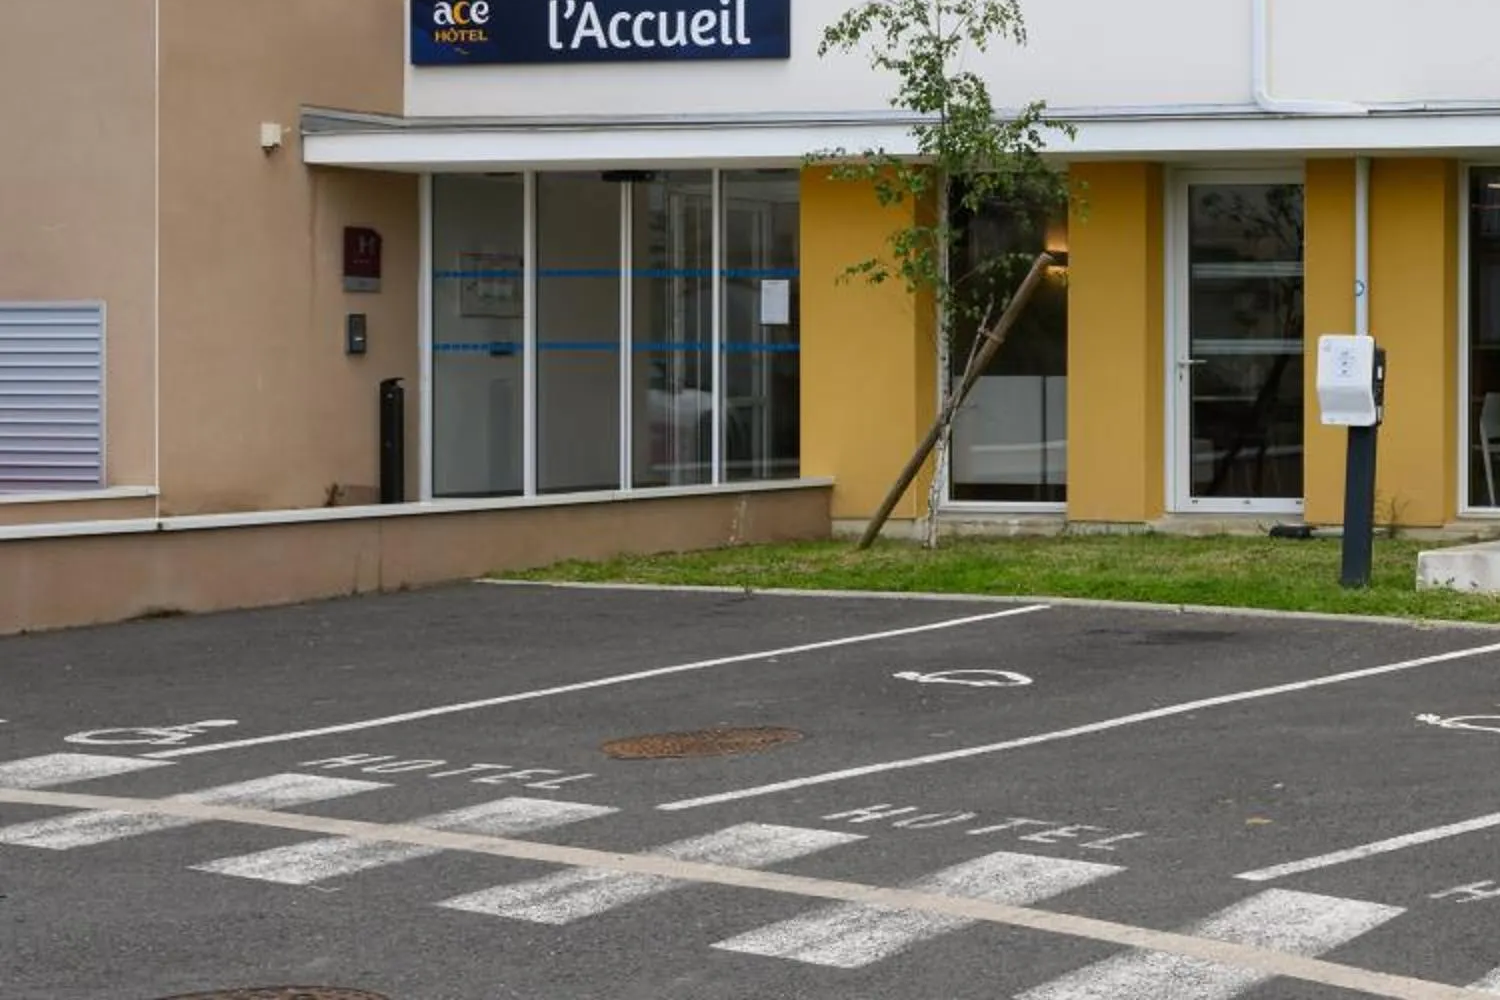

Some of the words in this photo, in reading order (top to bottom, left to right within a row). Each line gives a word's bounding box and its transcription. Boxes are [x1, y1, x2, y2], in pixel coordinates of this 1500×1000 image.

[433, 0, 489, 25] ace
[434, 27, 488, 42] HÔTEL
[297, 753, 597, 789] HOTEL
[820, 803, 1148, 850] HOTEL
